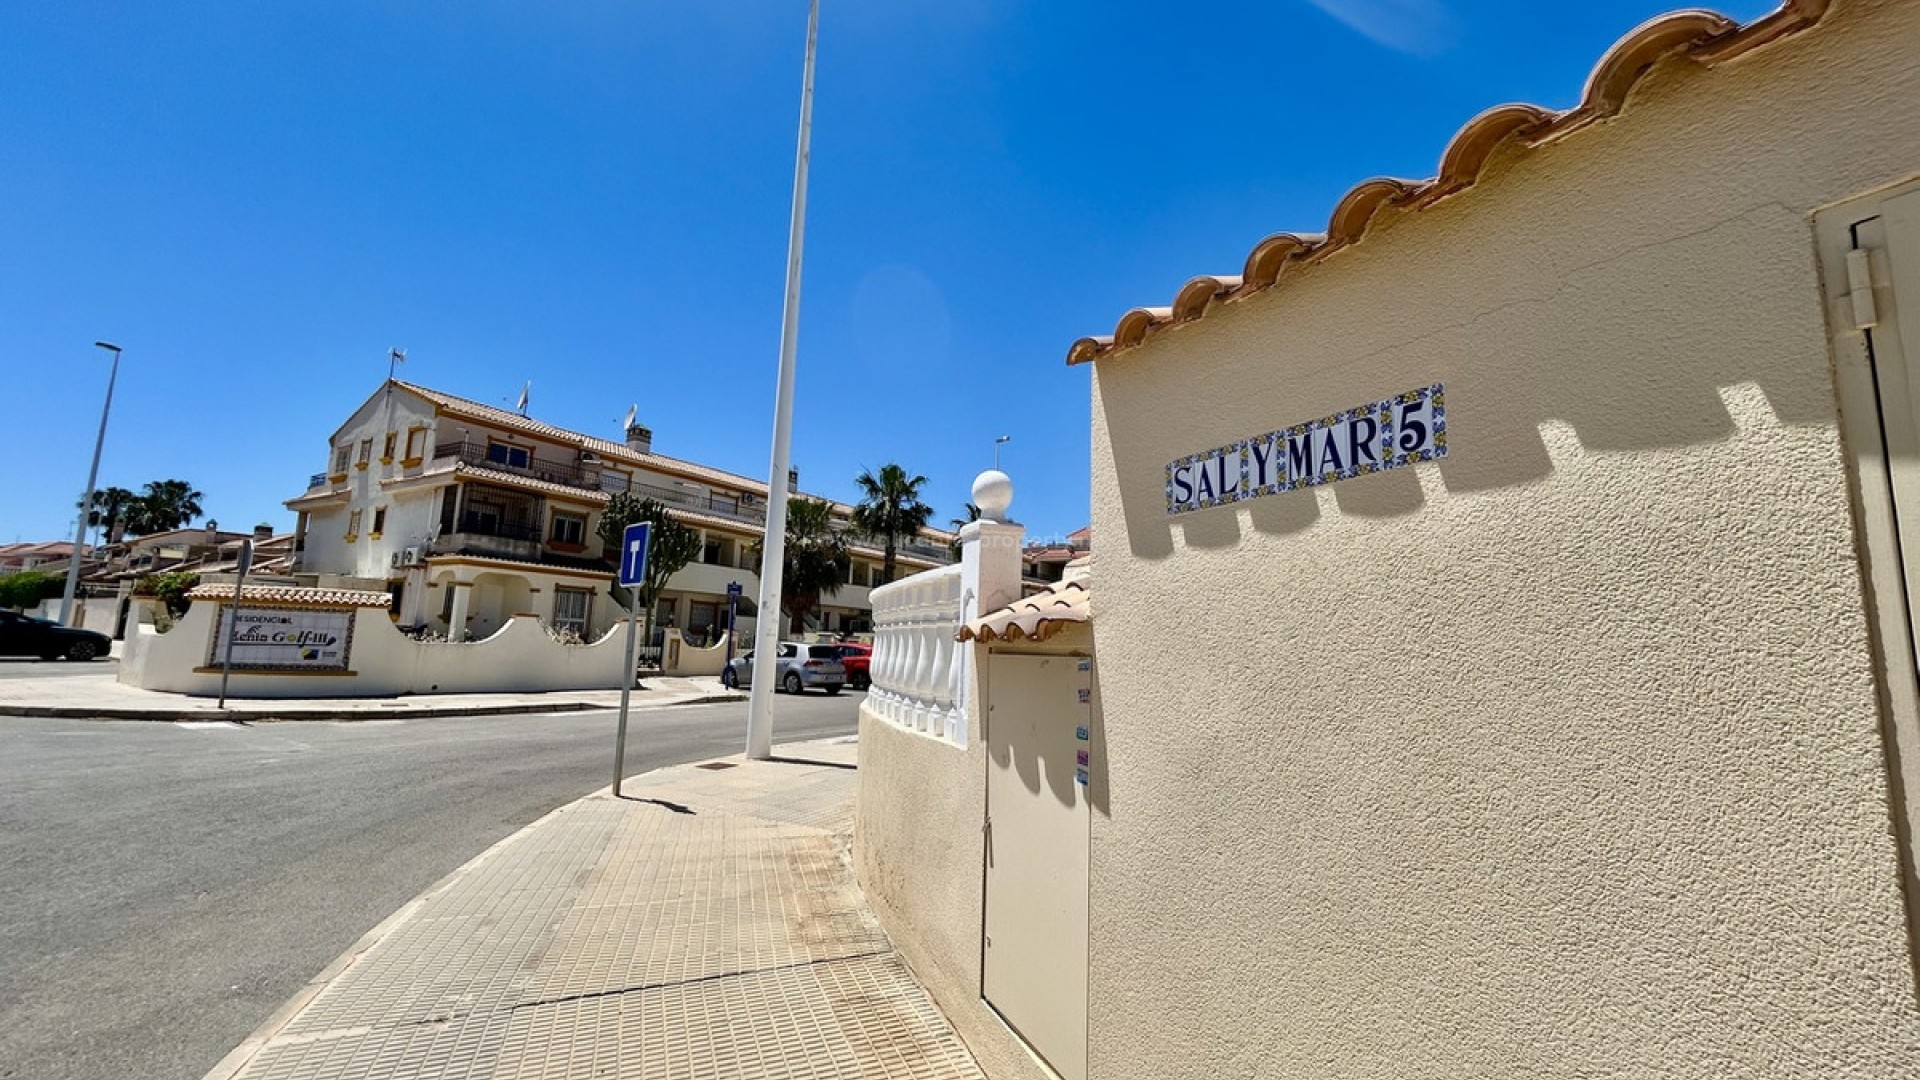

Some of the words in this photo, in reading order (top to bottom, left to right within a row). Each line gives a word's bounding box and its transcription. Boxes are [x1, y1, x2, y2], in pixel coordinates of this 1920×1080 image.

[1174, 452, 1239, 504] SAL
[1250, 441, 1273, 486] Y
[1287, 417, 1377, 480] MAR
[1399, 400, 1427, 452] 5
